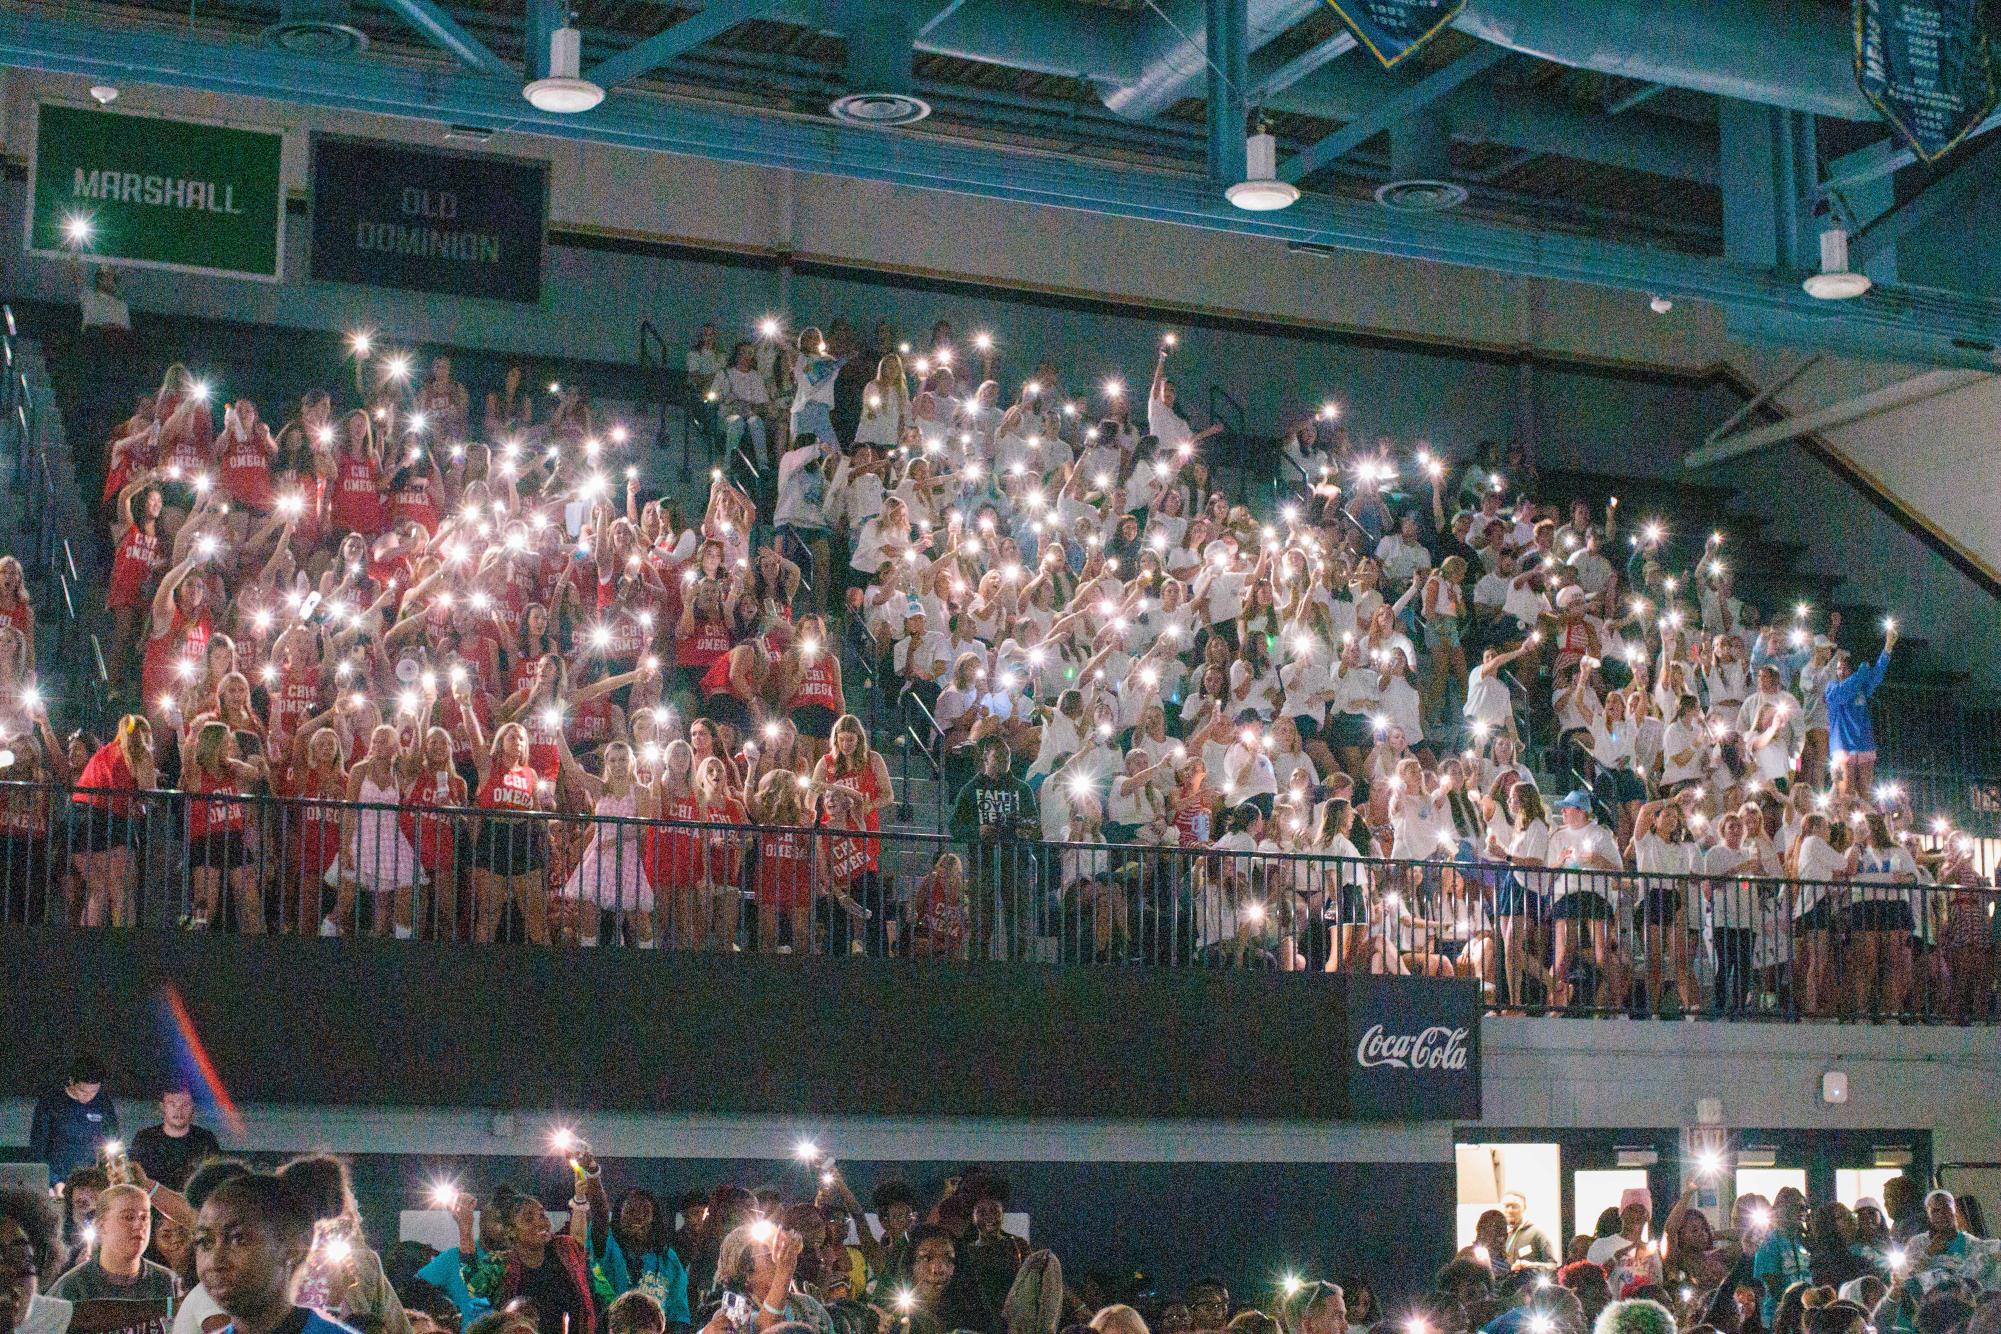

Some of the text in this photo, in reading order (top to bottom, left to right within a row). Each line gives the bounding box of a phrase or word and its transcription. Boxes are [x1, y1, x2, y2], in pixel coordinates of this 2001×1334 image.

[73, 166, 242, 215] MARSHALL
[402, 186, 458, 219] OLD
[356, 220, 500, 264] DOMINION
[697, 639, 730, 651] OMEG
[806, 667, 825, 681] CHI
[504, 774, 527, 789] CHI
[494, 787, 533, 807] OMEGA
[976, 789, 1020, 800] FAITH
[669, 803, 693, 820] CHI
[1357, 1024, 1469, 1070] Coca-Cola
